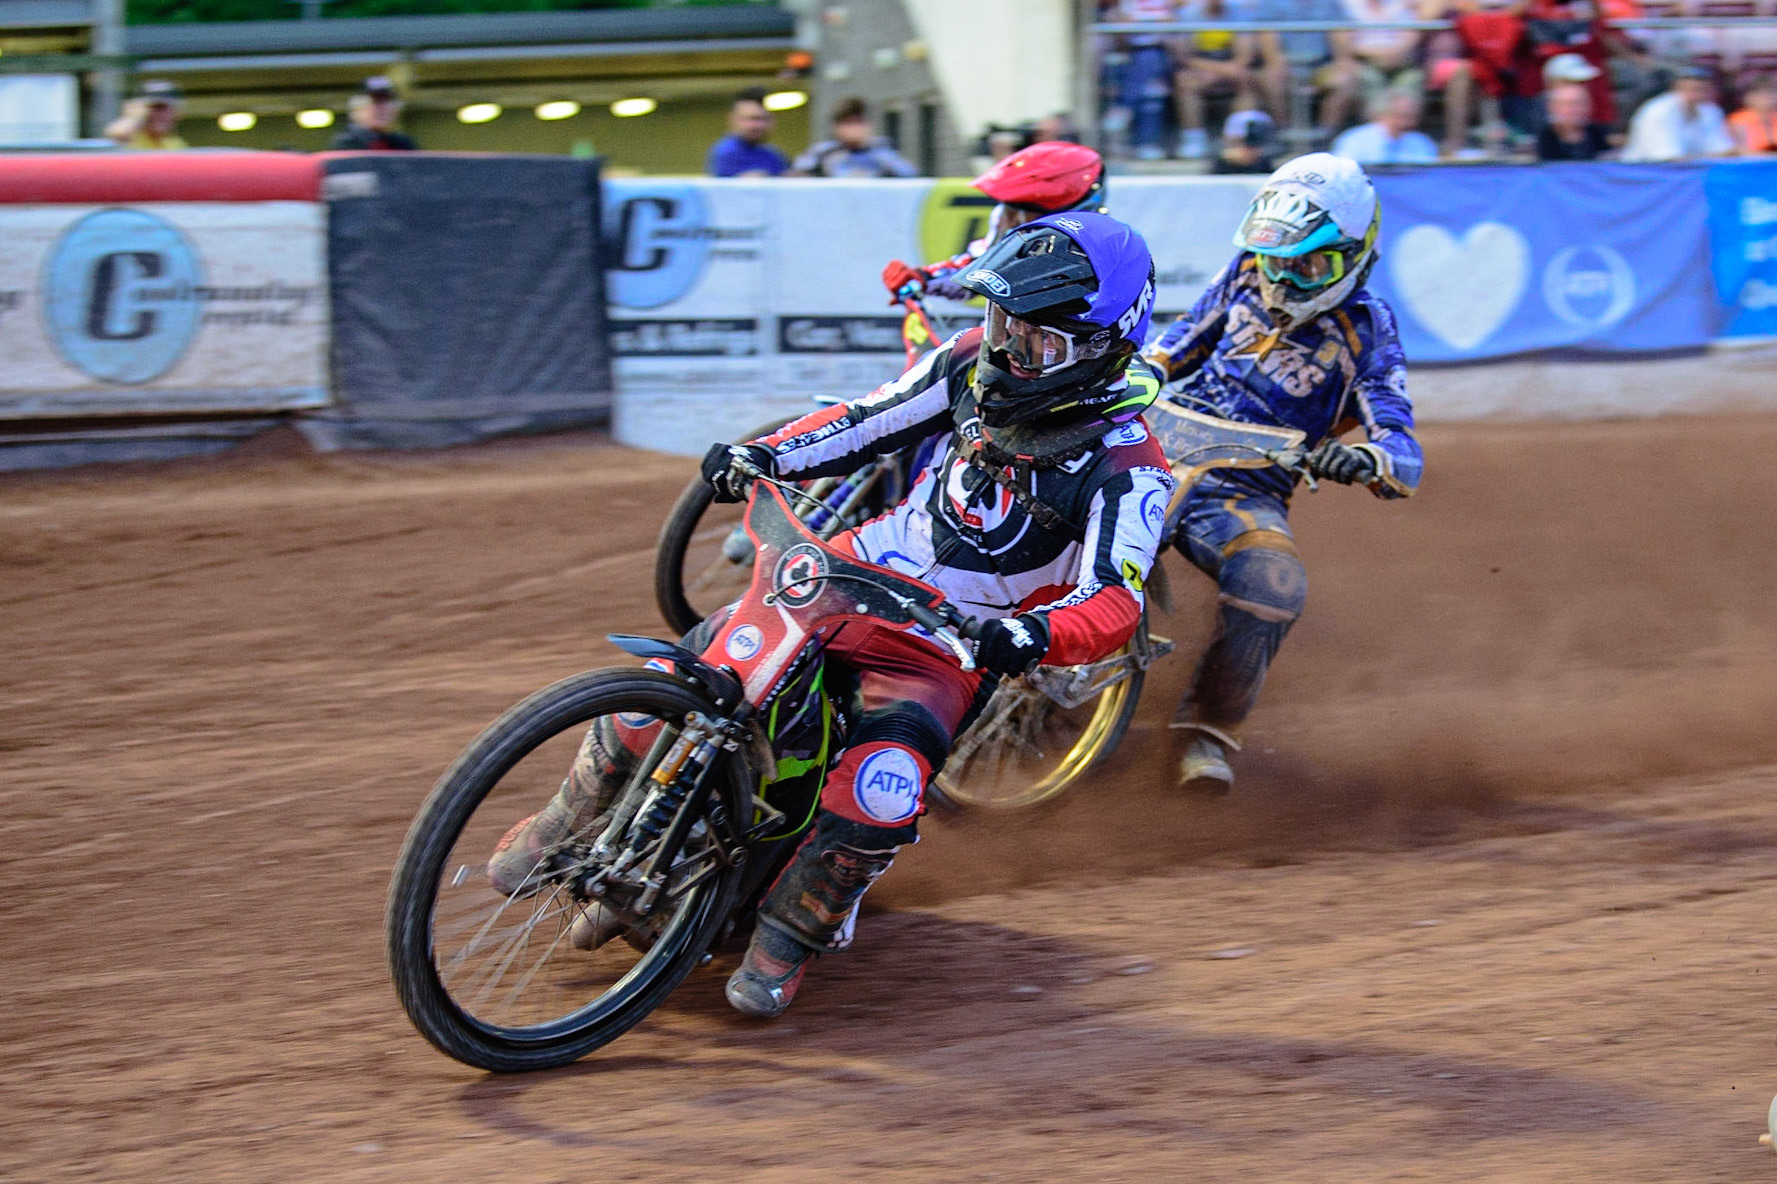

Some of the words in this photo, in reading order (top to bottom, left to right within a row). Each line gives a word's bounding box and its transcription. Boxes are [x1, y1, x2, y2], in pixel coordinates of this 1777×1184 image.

[969, 270, 1008, 293] SHOEI
[1224, 303, 1326, 398] STRS
[866, 769, 915, 799] ATPI
